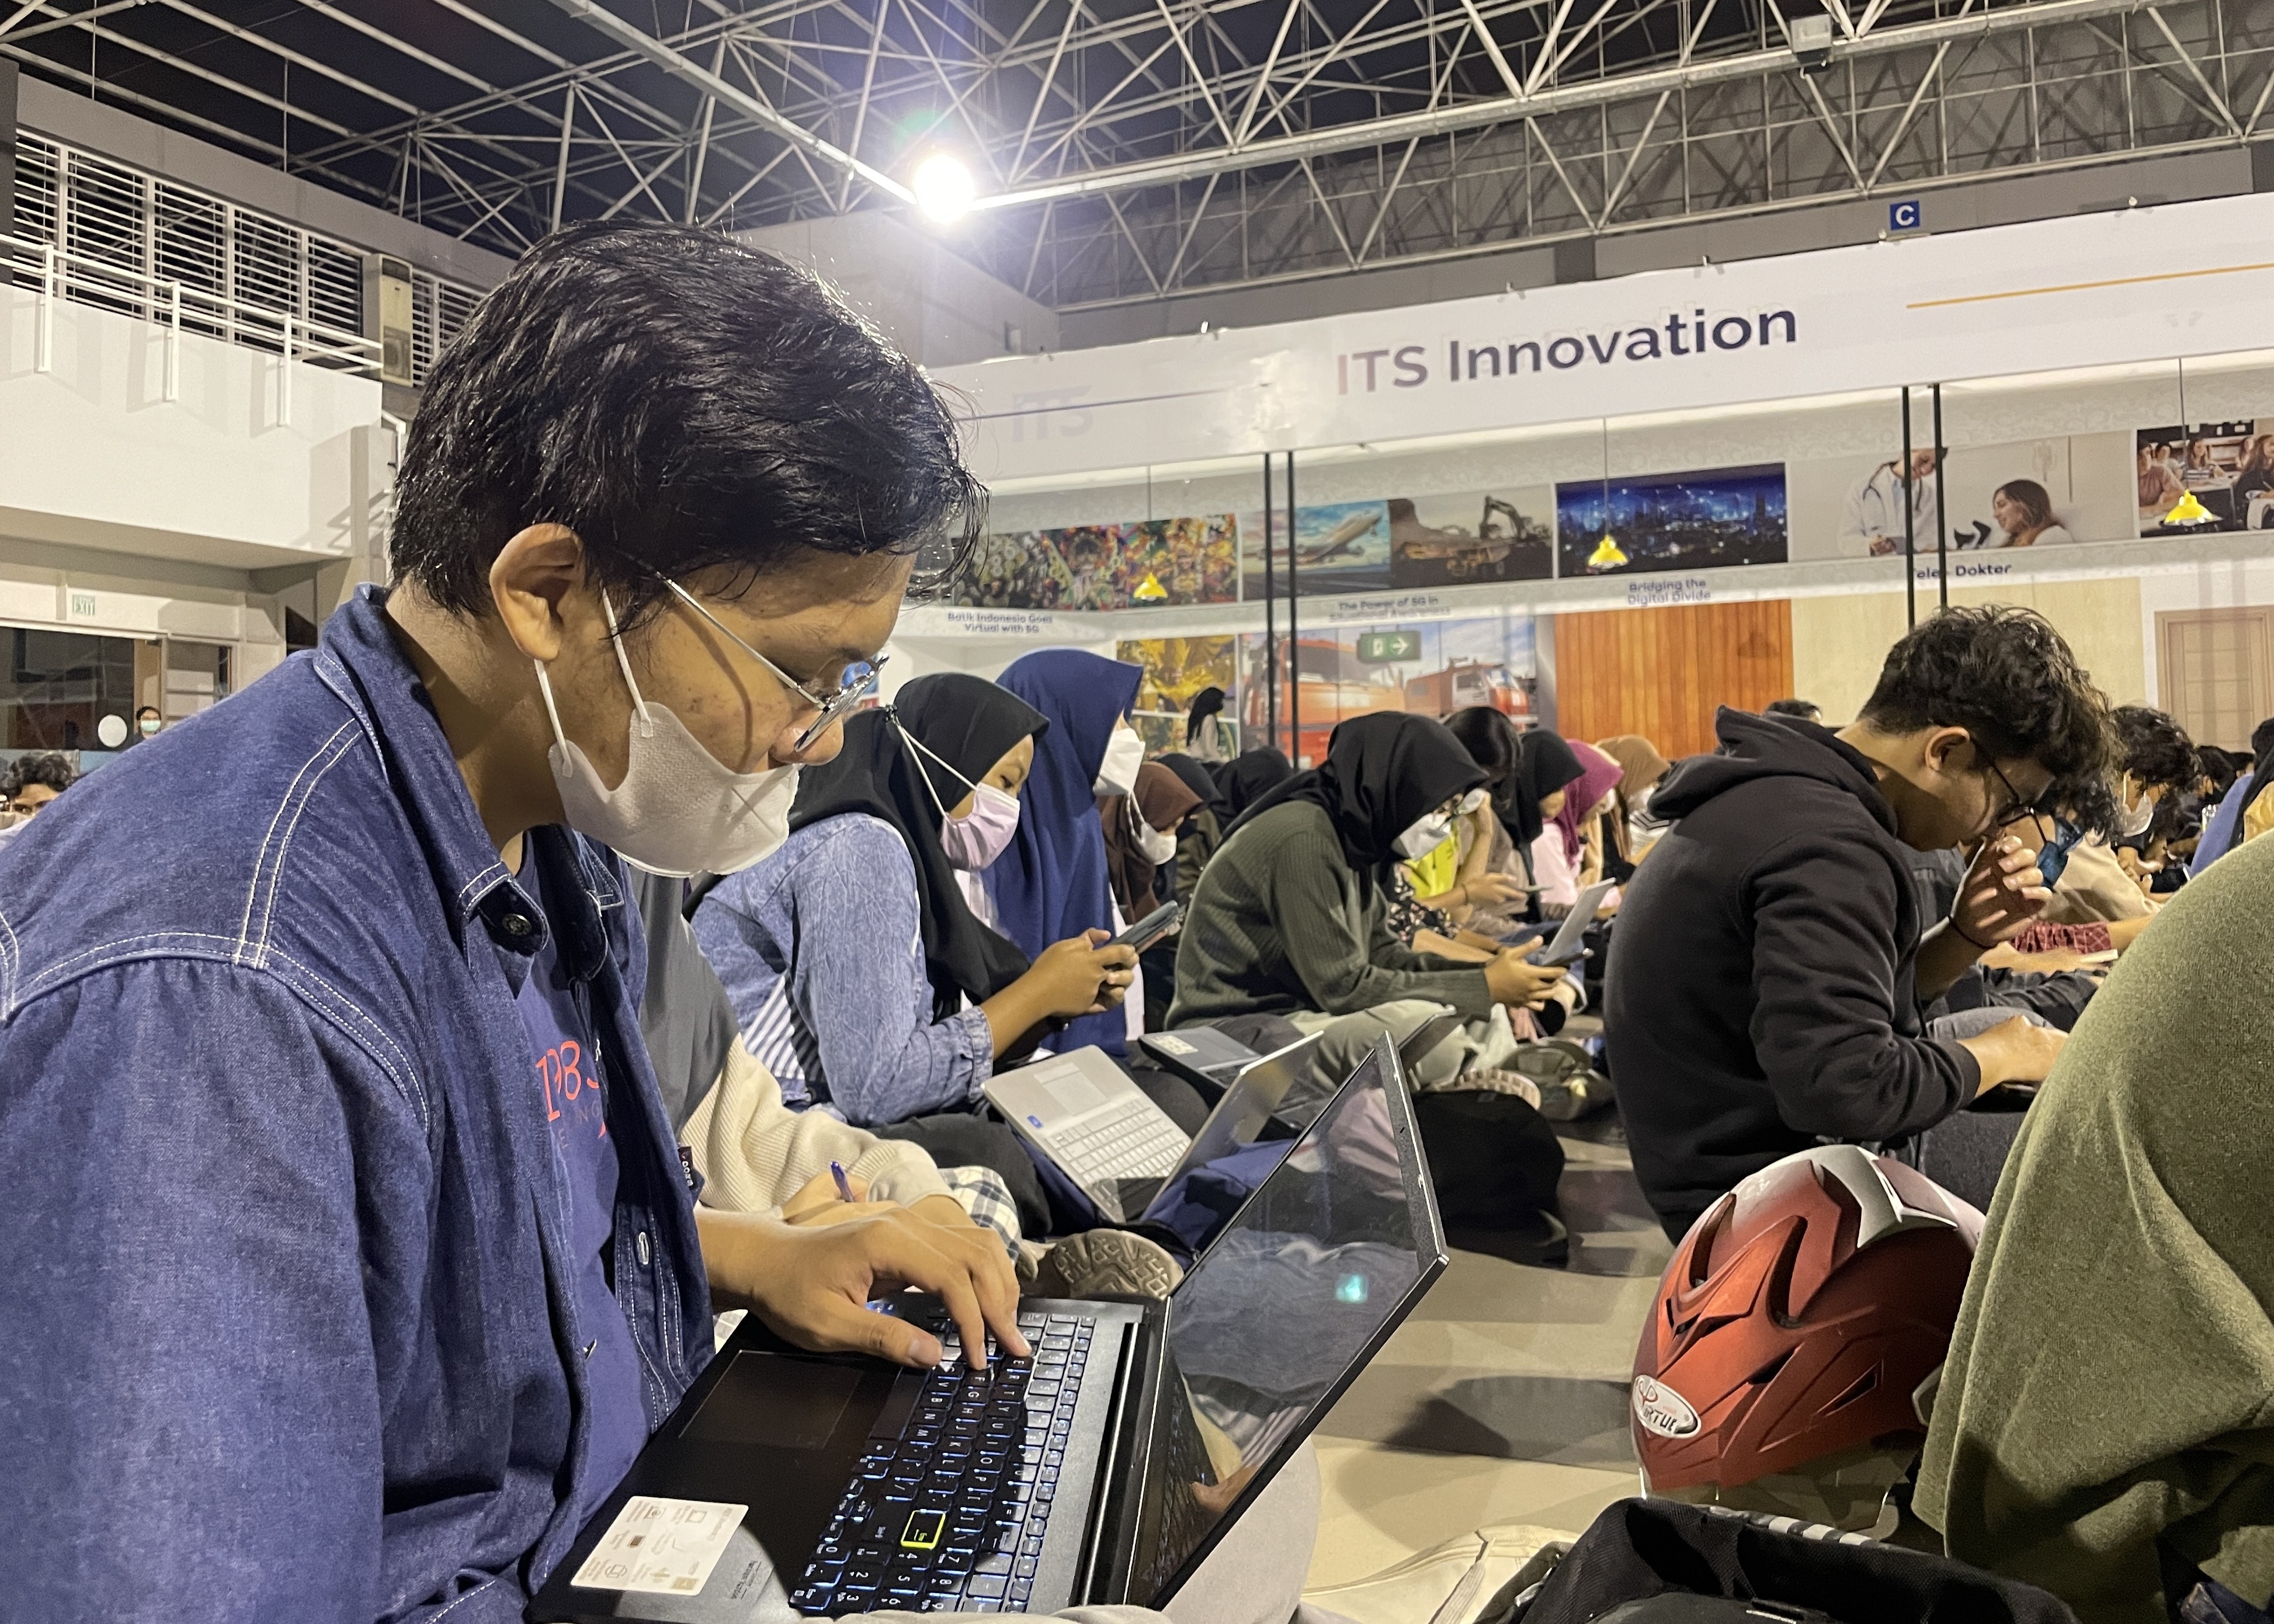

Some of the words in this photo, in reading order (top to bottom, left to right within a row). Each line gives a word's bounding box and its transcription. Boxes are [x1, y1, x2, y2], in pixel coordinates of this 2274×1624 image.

[1895, 204, 1915, 226] C
[1337, 346, 1429, 395] ITS
[1449, 308, 1797, 383] Innovation
[1955, 563, 2012, 576] Dokter
[1629, 580, 1683, 593] Bridging
[1685, 578, 1707, 589] the
[1397, 597, 1409, 607] of
[1628, 592, 1668, 607] Digital
[1672, 590, 1711, 603] Divide
[947, 611, 974, 622] Batik
[977, 613, 1027, 623] Indonesia
[1029, 614, 1053, 624] Goes
[964, 623, 999, 632] Virtual
[1002, 624, 1024, 632] with
